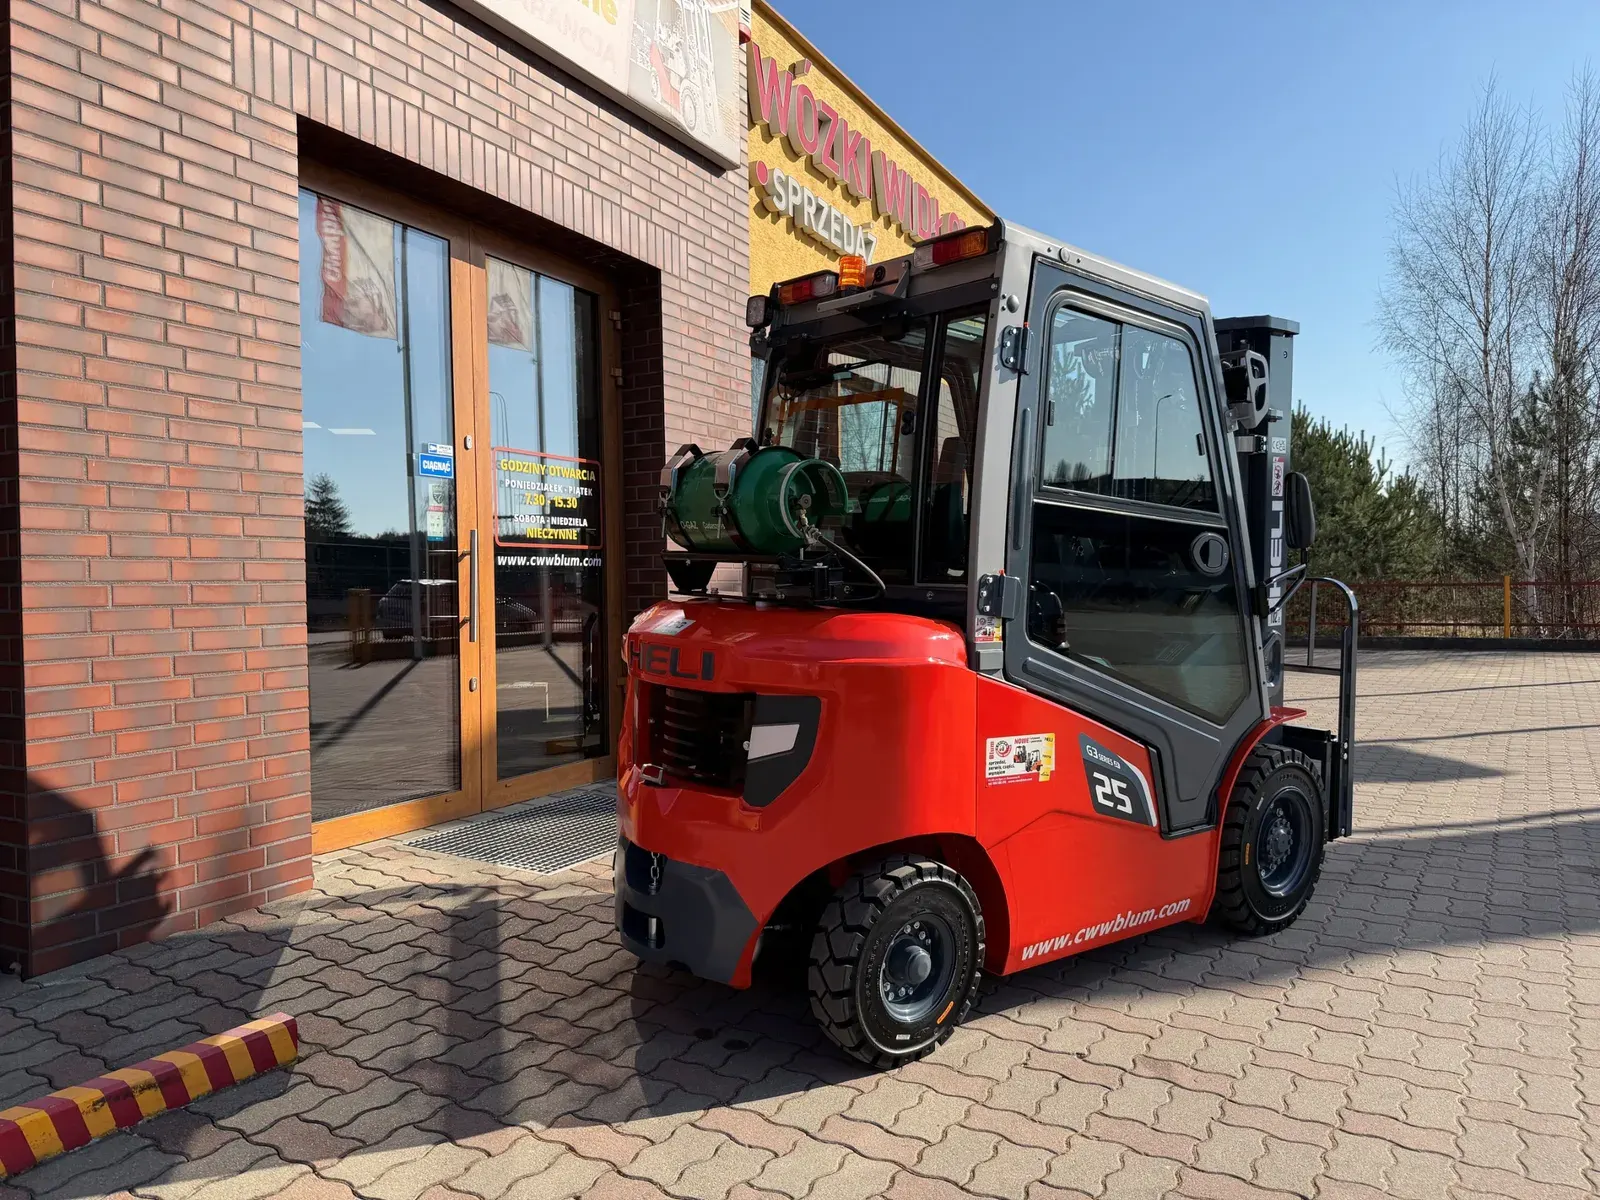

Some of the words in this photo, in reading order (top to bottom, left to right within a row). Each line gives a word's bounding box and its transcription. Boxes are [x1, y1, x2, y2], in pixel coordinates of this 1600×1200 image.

[751, 41, 872, 201] WÓZKI
[422, 459, 451, 474] CIĄGNĄĆ
[500, 458, 546, 476] GODZINY
[549, 465, 596, 481] OTWARCIA
[505, 479, 563, 493] PONIEDZIAŁEK
[569, 485, 593, 497] PIĄTEK
[525, 493, 545, 506] 7.30
[554, 496, 578, 509] 15.30
[514, 514, 545, 525] SOBOTA
[551, 517, 588, 527] NIEDZIELA
[526, 528, 578, 540] NIECZYNNE
[1270, 500, 1284, 598] HELI
[497, 554, 602, 567] www.cwwblum.com
[629, 640, 715, 681] HELI
[1093, 771, 1133, 815] 25
[1021, 897, 1191, 962] www.cwwblum.com
